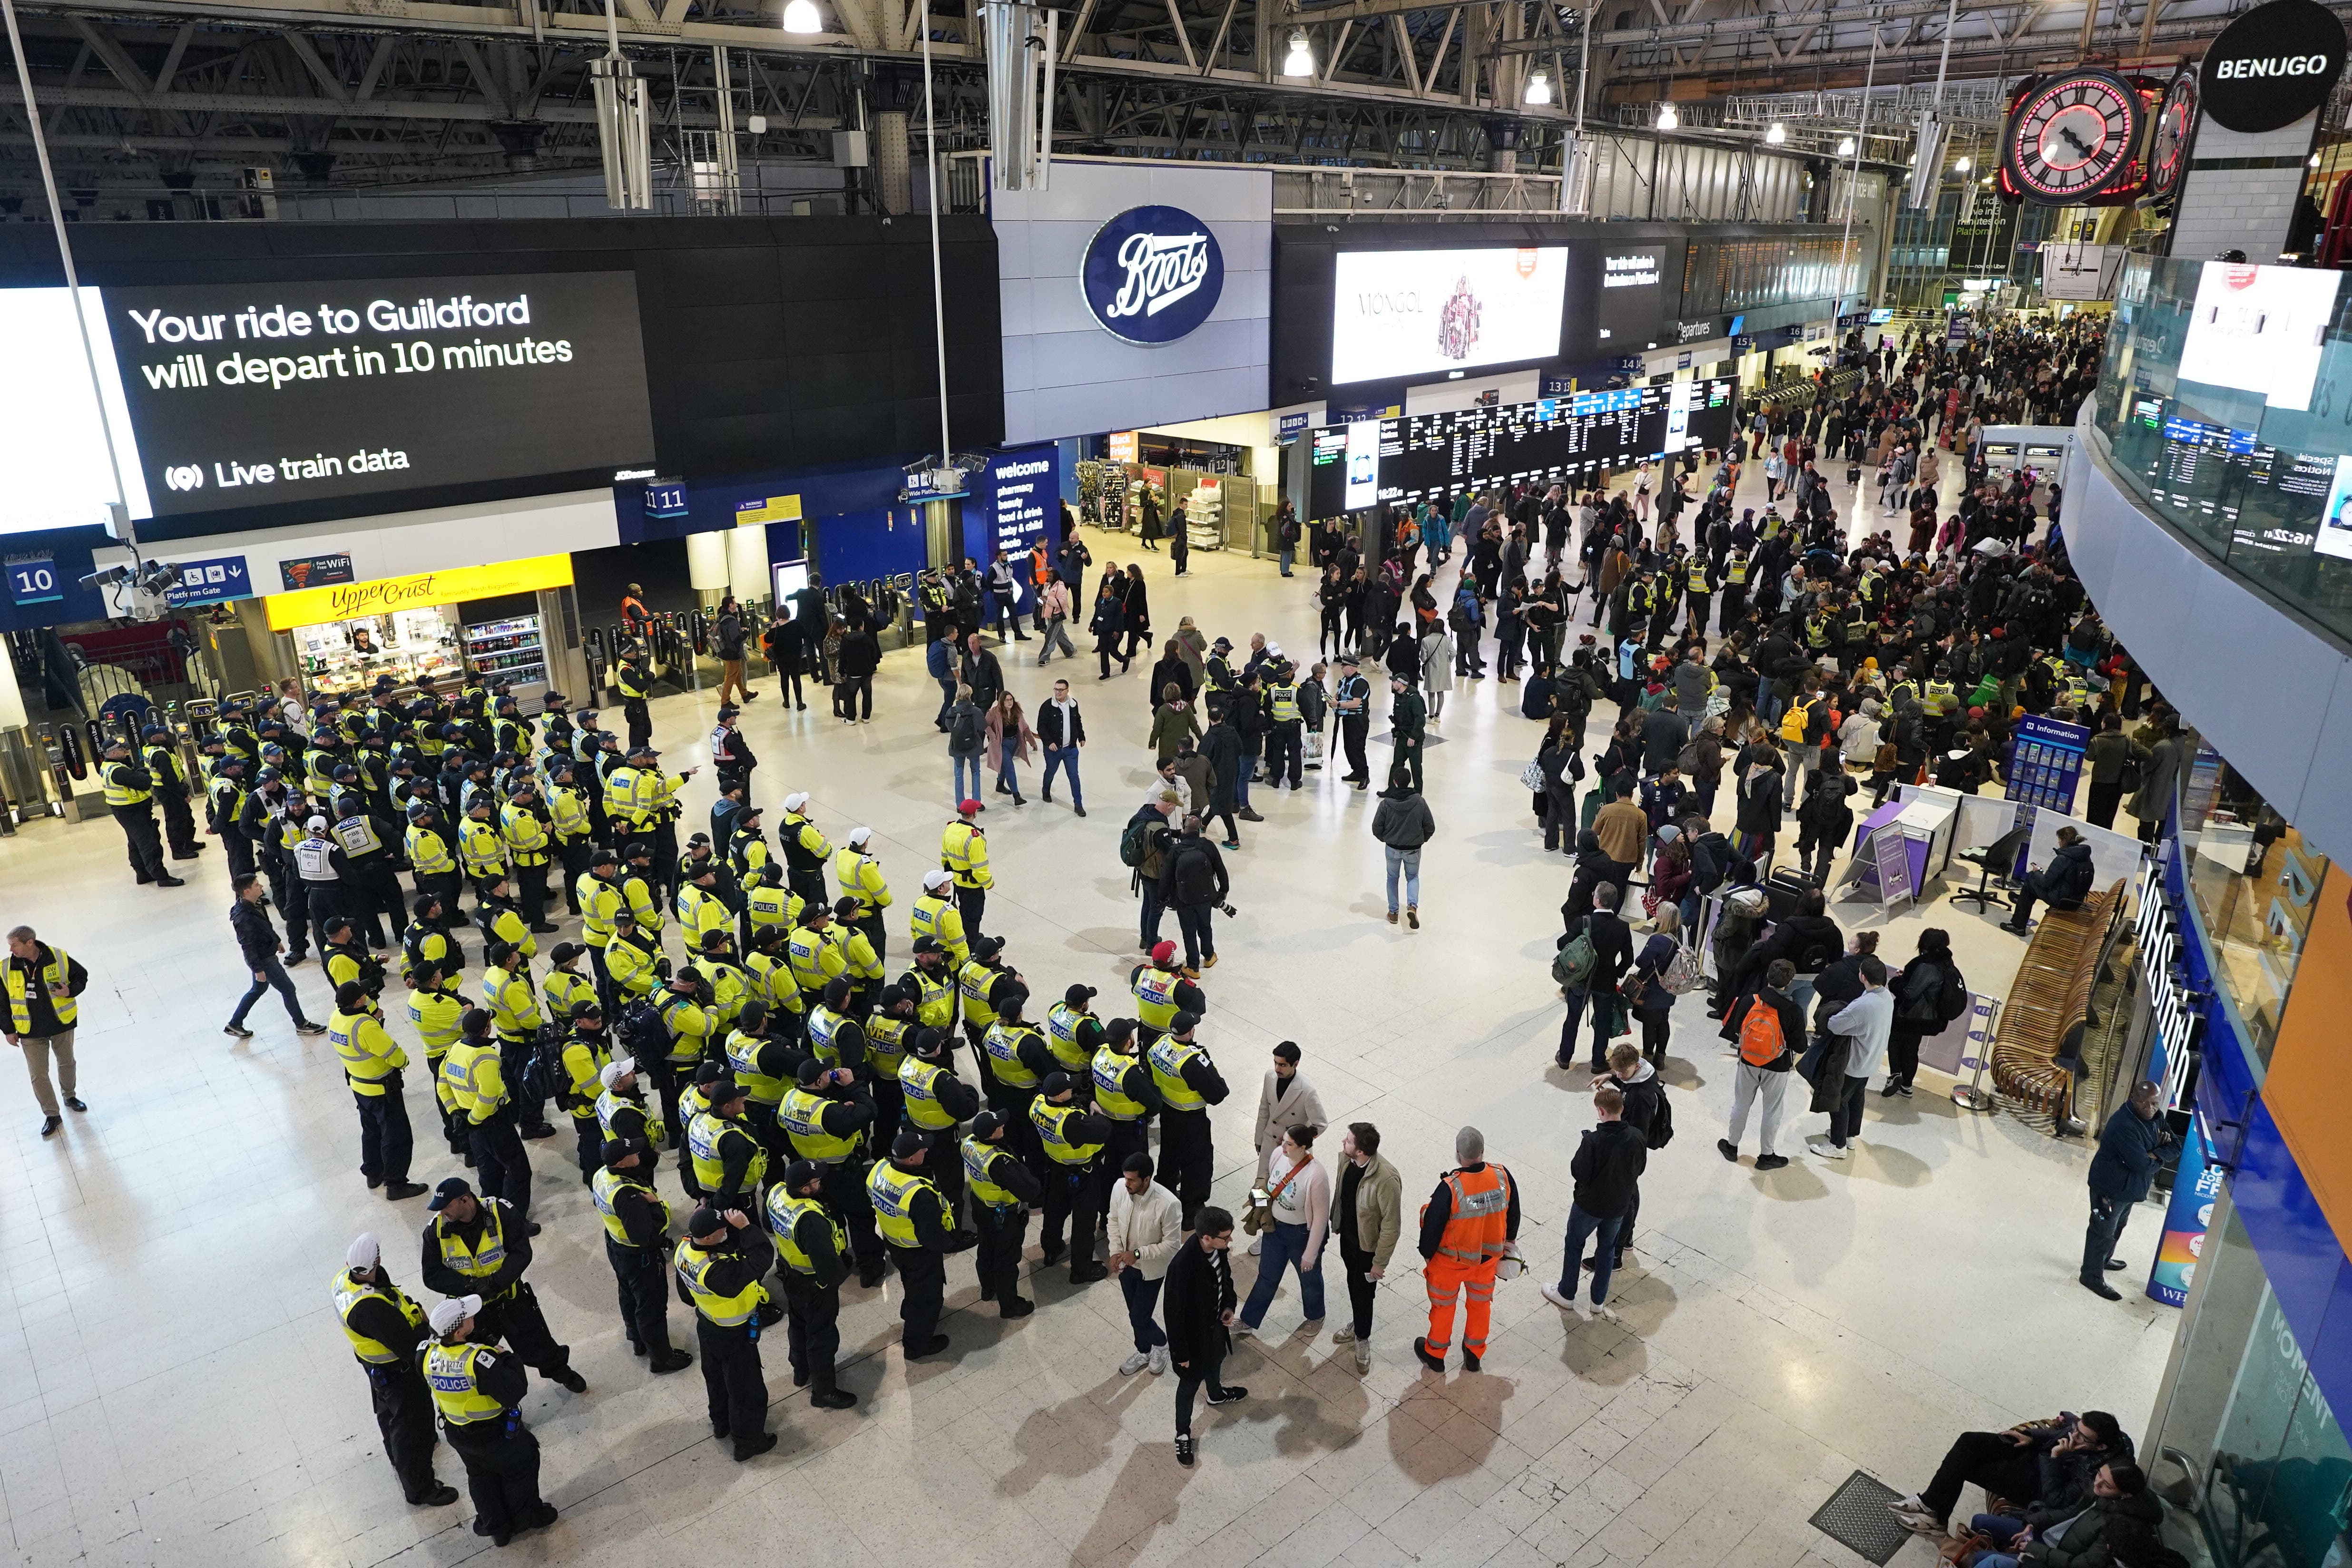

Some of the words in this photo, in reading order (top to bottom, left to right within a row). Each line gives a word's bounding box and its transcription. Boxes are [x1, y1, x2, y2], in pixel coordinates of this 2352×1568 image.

[2217, 54, 2327, 79] BENUGO
[1107, 232, 1208, 318] Boots
[1358, 291, 1423, 317] MONGOL
[128, 308, 225, 343] Your
[235, 304, 312, 340] ride
[317, 304, 360, 335] to
[367, 294, 530, 333] Guildford
[1678, 322, 1710, 341] Departures
[1736, 337, 1747, 346] 15
[141, 353, 208, 390] will
[216, 344, 348, 390] depart
[353, 344, 387, 375] in
[394, 340, 435, 374] 10
[441, 334, 574, 369] minutes
[1622, 359, 1634, 369] 14
[1549, 382, 1561, 392] 13
[1341, 414, 1353, 423] 12
[1110, 434, 1130, 445] Black
[1110, 445, 1133, 456] Friday
[214, 459, 275, 488] Live
[279, 453, 343, 481] train
[347, 447, 410, 475] data
[996, 459, 1049, 480] welcome
[1216, 460, 1225, 470] 12
[998, 482, 1034, 498] pharmacy
[645, 490, 657, 509] 11
[661, 490, 684, 509] 11
[998, 497, 1023, 510] beauty
[998, 510, 1015, 523] food
[1017, 510, 1022, 519] &
[1024, 506, 1043, 518] drink
[999, 524, 1016, 538] baby
[1018, 525, 1023, 534] &
[1025, 519, 1043, 531] child
[1000, 538, 1021, 550] photo
[326, 558, 350, 569] WiFi
[16, 569, 53, 593] 10
[167, 588, 200, 600] Platform
[202, 587, 221, 596] Gate
[332, 581, 387, 617] Upper
[384, 575, 436, 604] Crust
[441, 588, 469, 598] famously
[487, 581, 519, 592] baguettes
[2037, 724, 2079, 740] Information
[338, 817, 360, 829] POLICE
[678, 897, 689, 912] POLICE
[754, 902, 777, 913] POLICE
[913, 908, 931, 923] POLICE
[791, 943, 809, 958] POLICE
[960, 983, 978, 999] POLICE
[2136, 860, 2195, 1109] WHSmith
[1141, 990, 1164, 1004] POLICE
[330, 1030, 348, 1046] POLICE
[811, 1029, 829, 1048] POLICE
[870, 1028, 884, 1040] VH
[1050, 1020, 1069, 1041] POLICE
[727, 1046, 737, 1056] VA
[871, 1041, 894, 1054] POLICE
[989, 1041, 1009, 1061] POLICE
[446, 1063, 466, 1079] POLICE
[1152, 1053, 1173, 1077] POLICE
[1092, 1069, 1114, 1091] POLICE
[902, 1082, 924, 1100] POLICE
[787, 1108, 798, 1119] VB
[1032, 1113, 1046, 1127] VH
[785, 1118, 808, 1135] POLICE
[689, 1138, 710, 1160] POLICE
[872, 1192, 896, 1217] POLICE
[482, 1253, 500, 1264] POLICE
[678, 1256, 689, 1271] VH
[689, 1263, 699, 1274] 1014
[449, 1360, 463, 1368] 2774
[2271, 1307, 2332, 1430] MOMENT
[433, 1375, 470, 1392] POLICE
